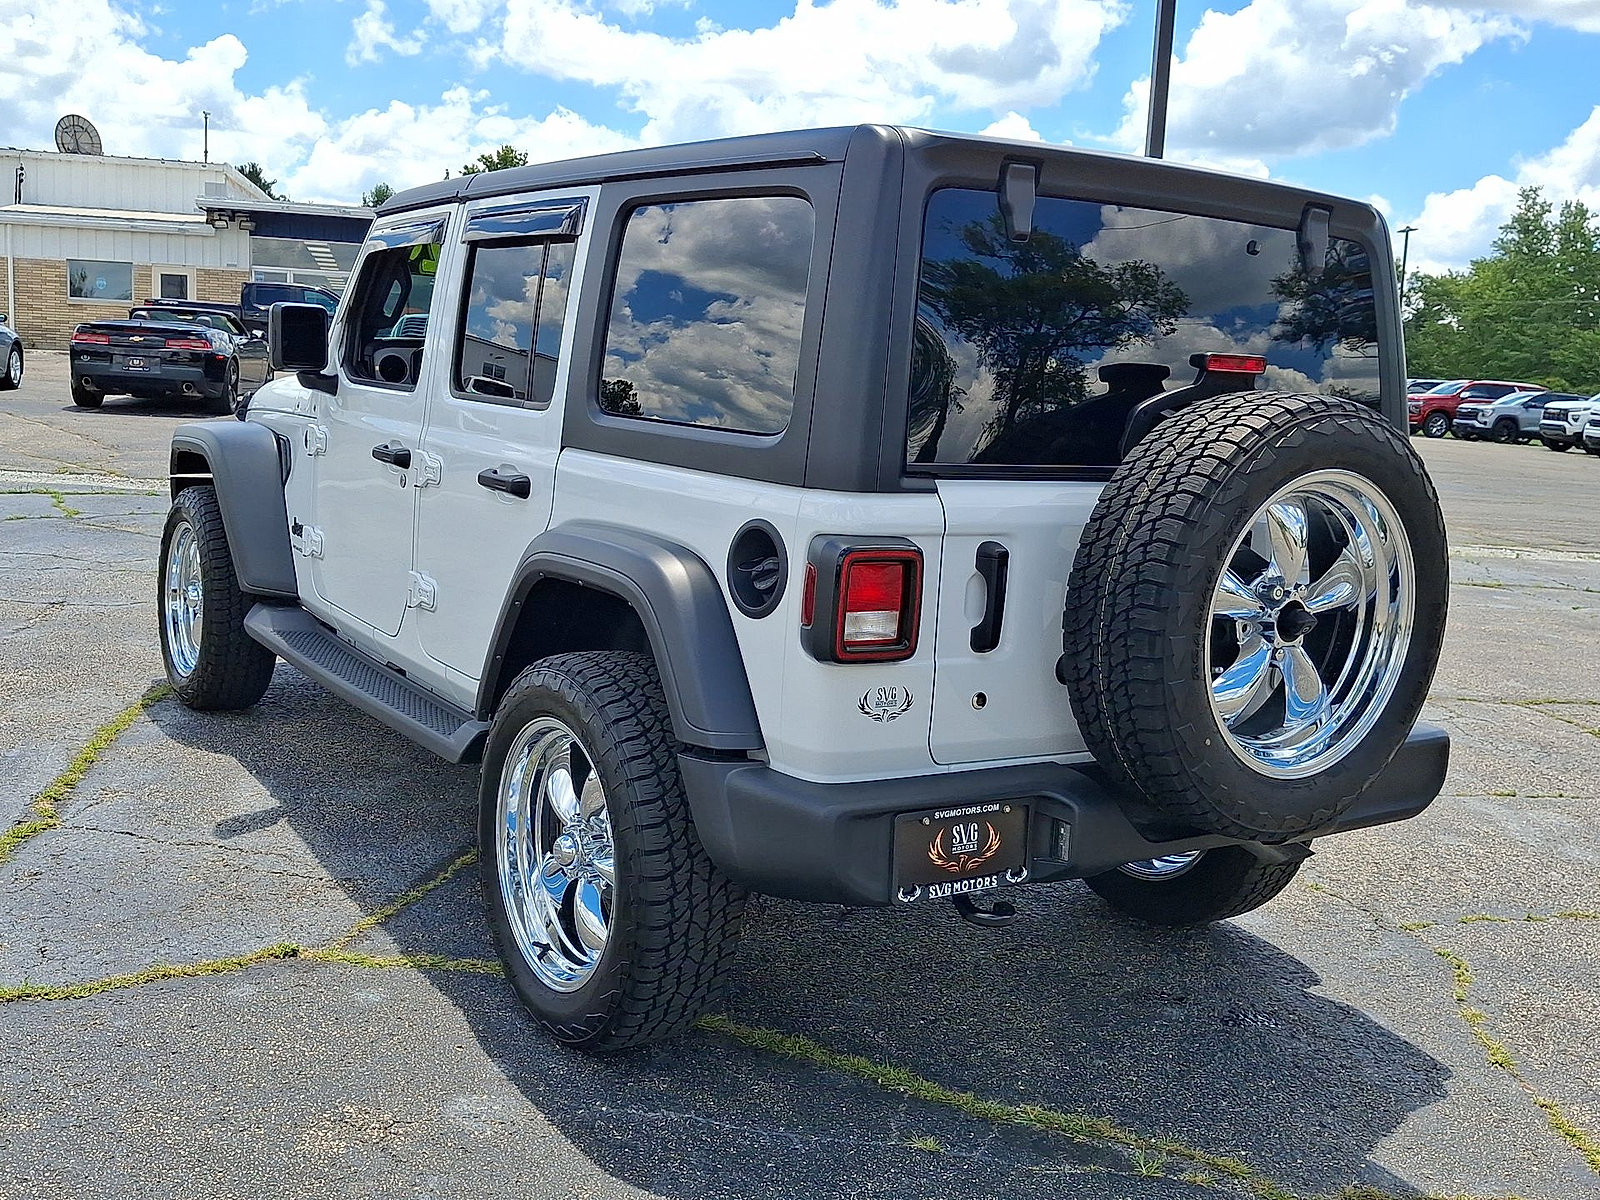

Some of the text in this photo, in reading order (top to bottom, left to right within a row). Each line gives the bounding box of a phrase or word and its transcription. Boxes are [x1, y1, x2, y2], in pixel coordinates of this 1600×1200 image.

[877, 686, 897, 701] SVG
[934, 803, 1000, 819] SVGMOTORS.COM
[952, 822, 978, 844] SVG
[952, 843, 978, 852] MOTORS
